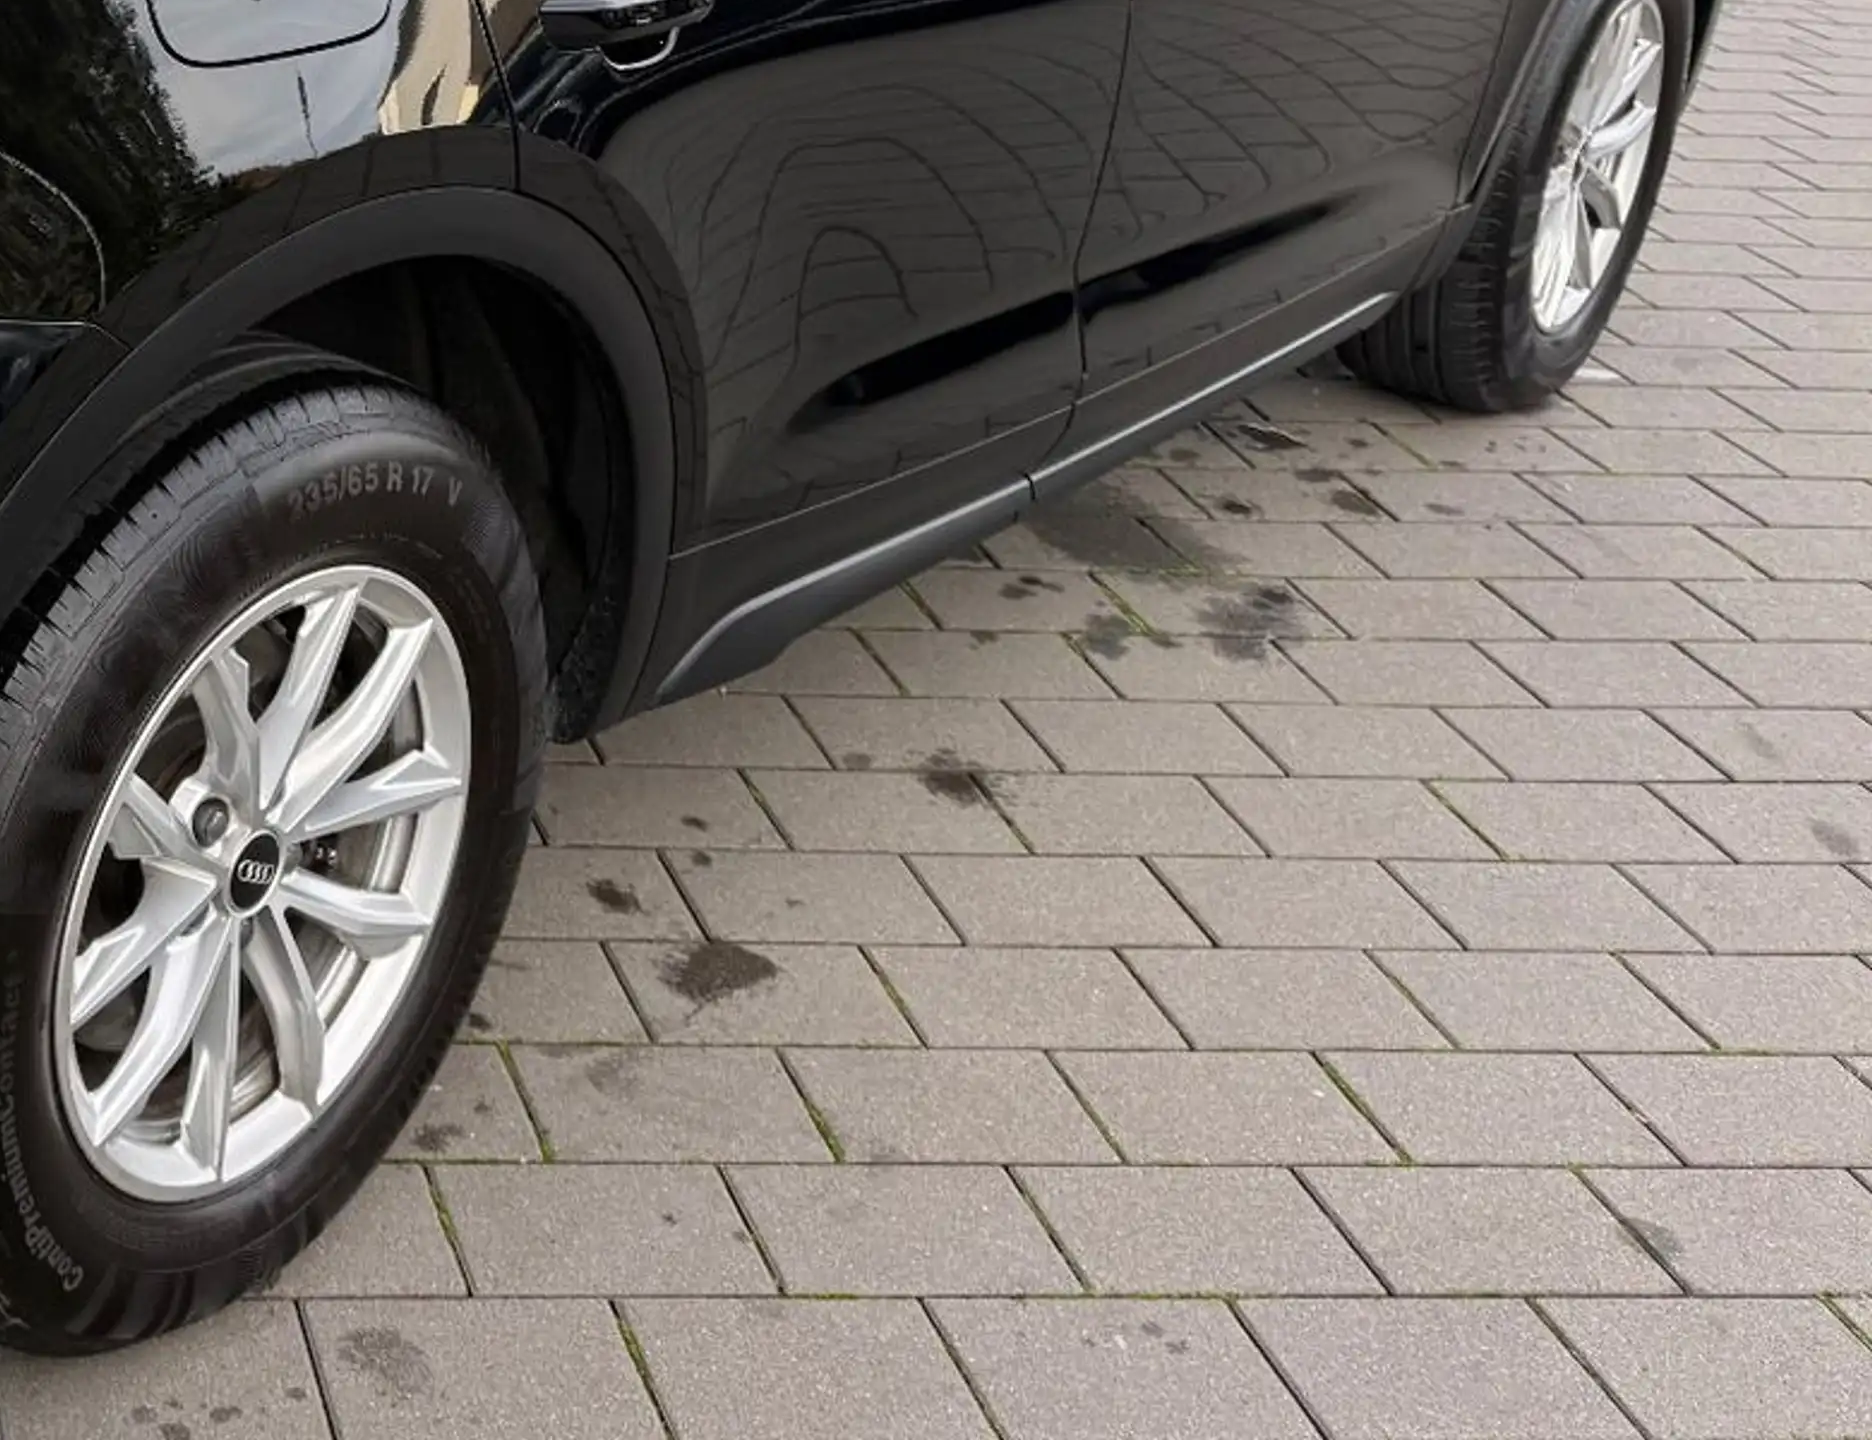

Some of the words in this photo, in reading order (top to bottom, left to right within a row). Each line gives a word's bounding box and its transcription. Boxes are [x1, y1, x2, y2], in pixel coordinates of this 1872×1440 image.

[287, 463, 379, 515] 235/65
[387, 462, 404, 493] R
[412, 465, 436, 498] 17
